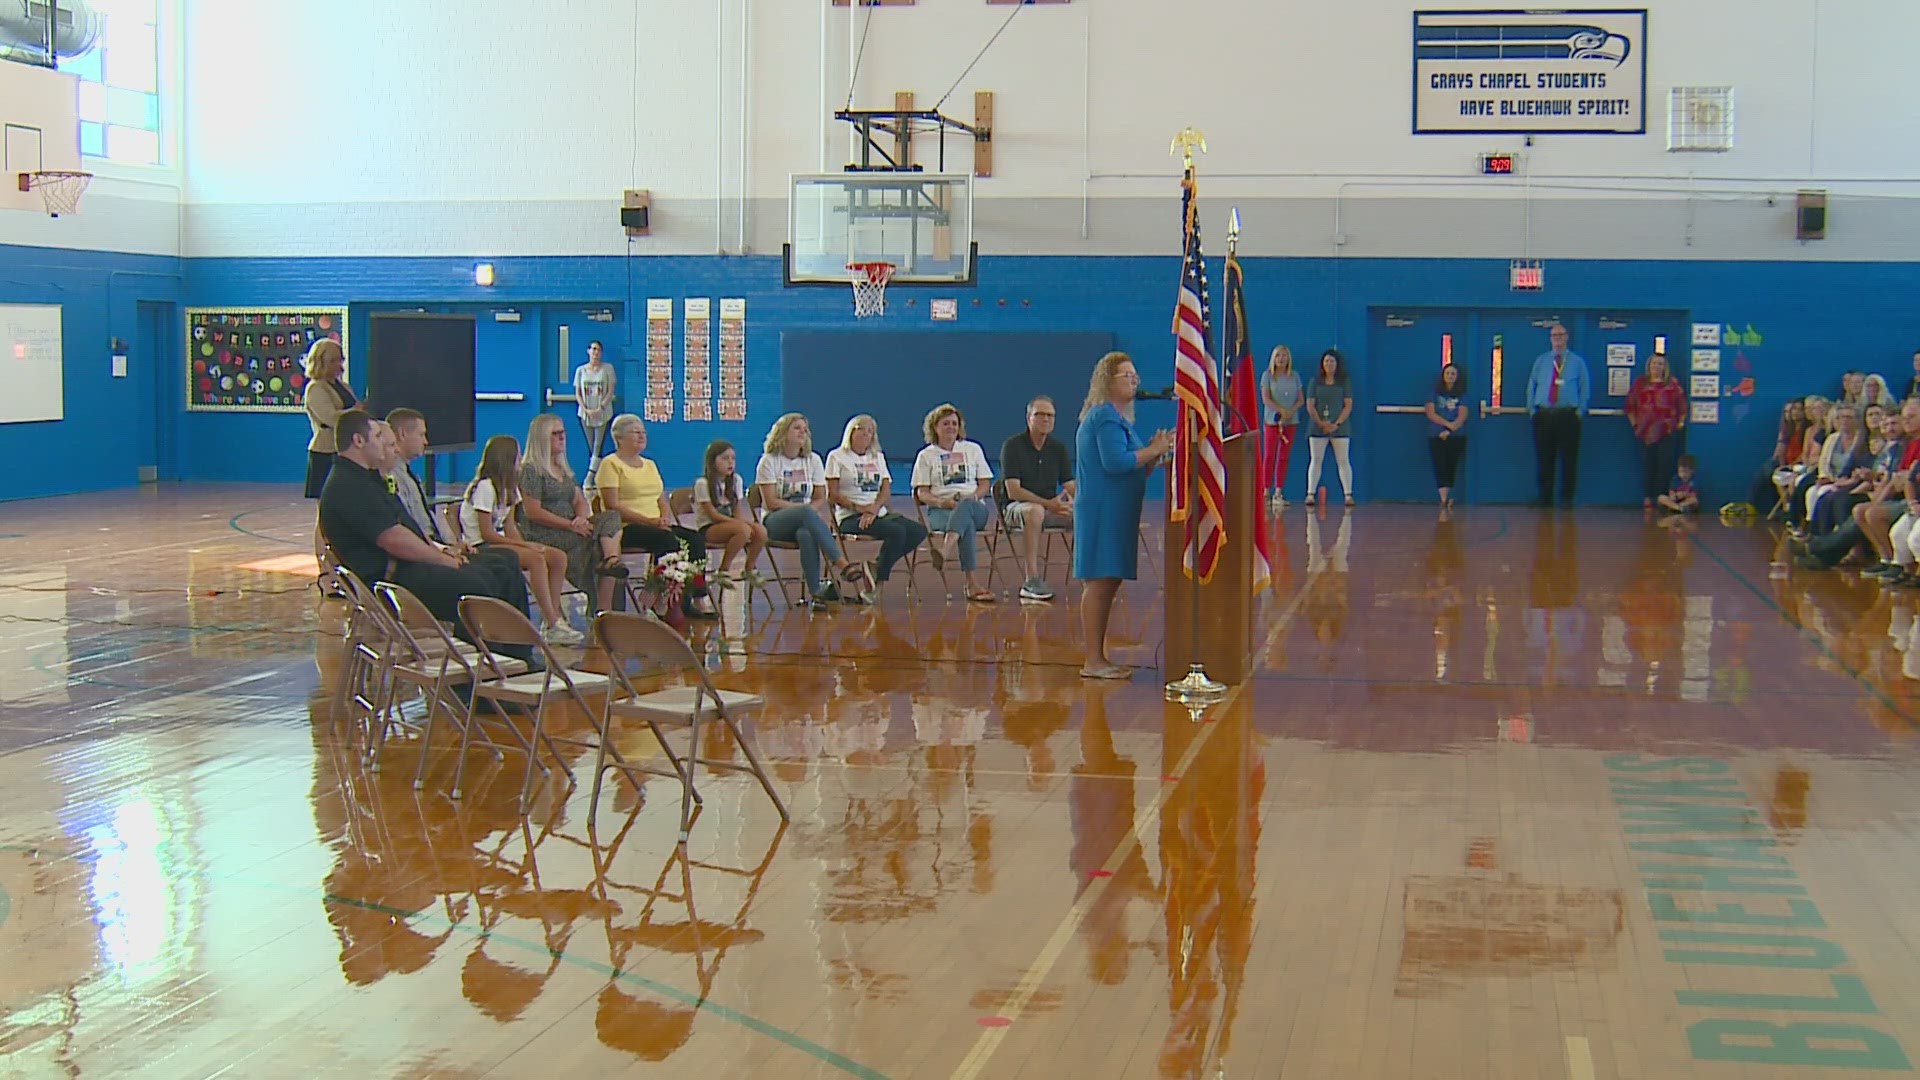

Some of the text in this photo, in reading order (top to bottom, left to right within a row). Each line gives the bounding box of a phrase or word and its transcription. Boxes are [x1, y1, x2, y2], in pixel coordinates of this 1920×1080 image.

[1430, 73, 1607, 89] GRAYS CHAPEL STUDENTS
[1460, 99, 1630, 116] HAVE BLUEHAWK SPIRIT!
[221, 314, 261, 328] Physical
[265, 314, 314, 326] Education
[213, 330, 315, 346] WELCOME
[204, 393, 233, 404] Where
[256, 394, 278, 404] have
[1603, 754, 1914, 1071] BLUEHAWKS
